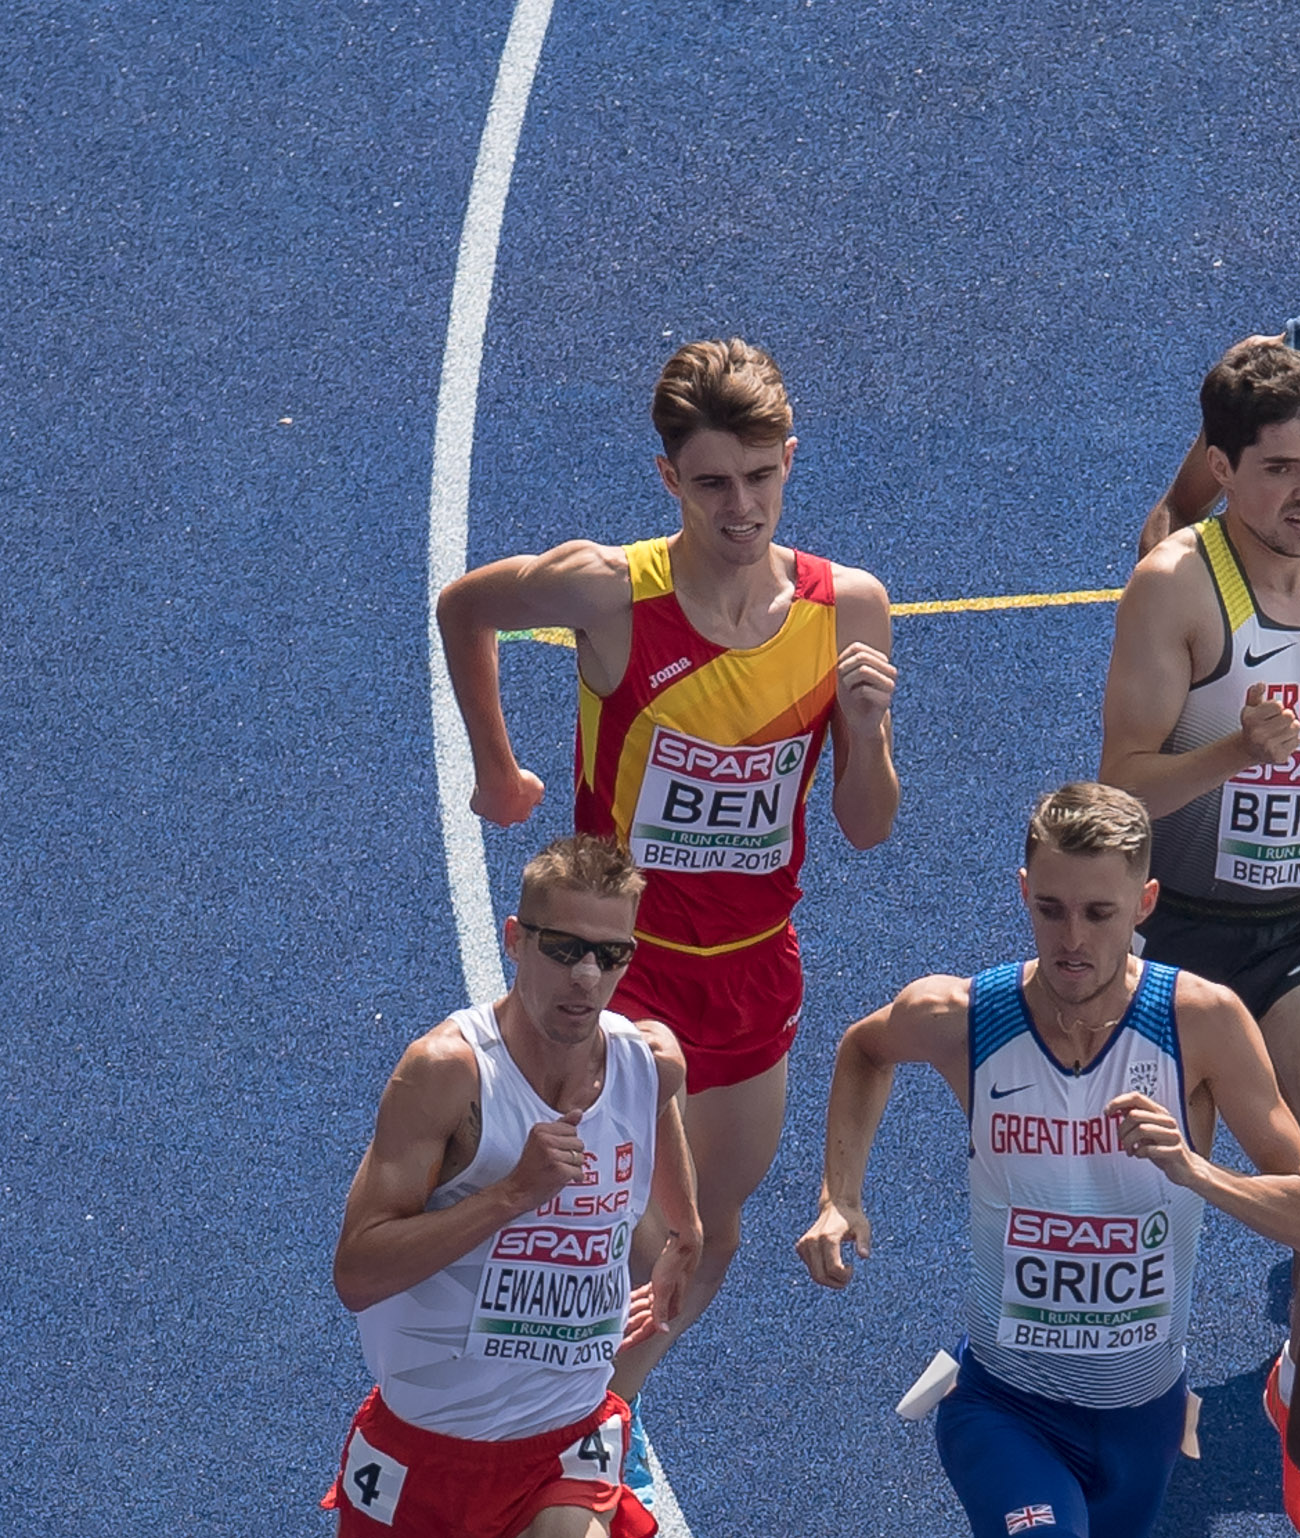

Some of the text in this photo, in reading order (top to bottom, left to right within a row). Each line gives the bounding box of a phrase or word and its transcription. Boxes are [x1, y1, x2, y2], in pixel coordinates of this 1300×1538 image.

[656, 739, 768, 779] SPAR
[662, 780, 781, 829] BEN
[670, 831, 677, 843] I
[678, 832, 712, 846] RUN
[1265, 847, 1295, 859] RUN
[644, 844, 782, 869] BERLIN 2018
[991, 1112, 1124, 1156] GREAT BRIT
[1013, 1214, 1134, 1249] SPAR
[498, 1232, 609, 1262] SPAR
[1015, 1253, 1165, 1305] GRICE
[520, 1322, 553, 1336] RUN
[1049, 1312, 1080, 1324] RUN
[1015, 1322, 1158, 1349] BERLIN 2018
[484, 1338, 614, 1366] BERLIN 2018
[577, 1430, 611, 1473] 4
[354, 1462, 382, 1506] 4
